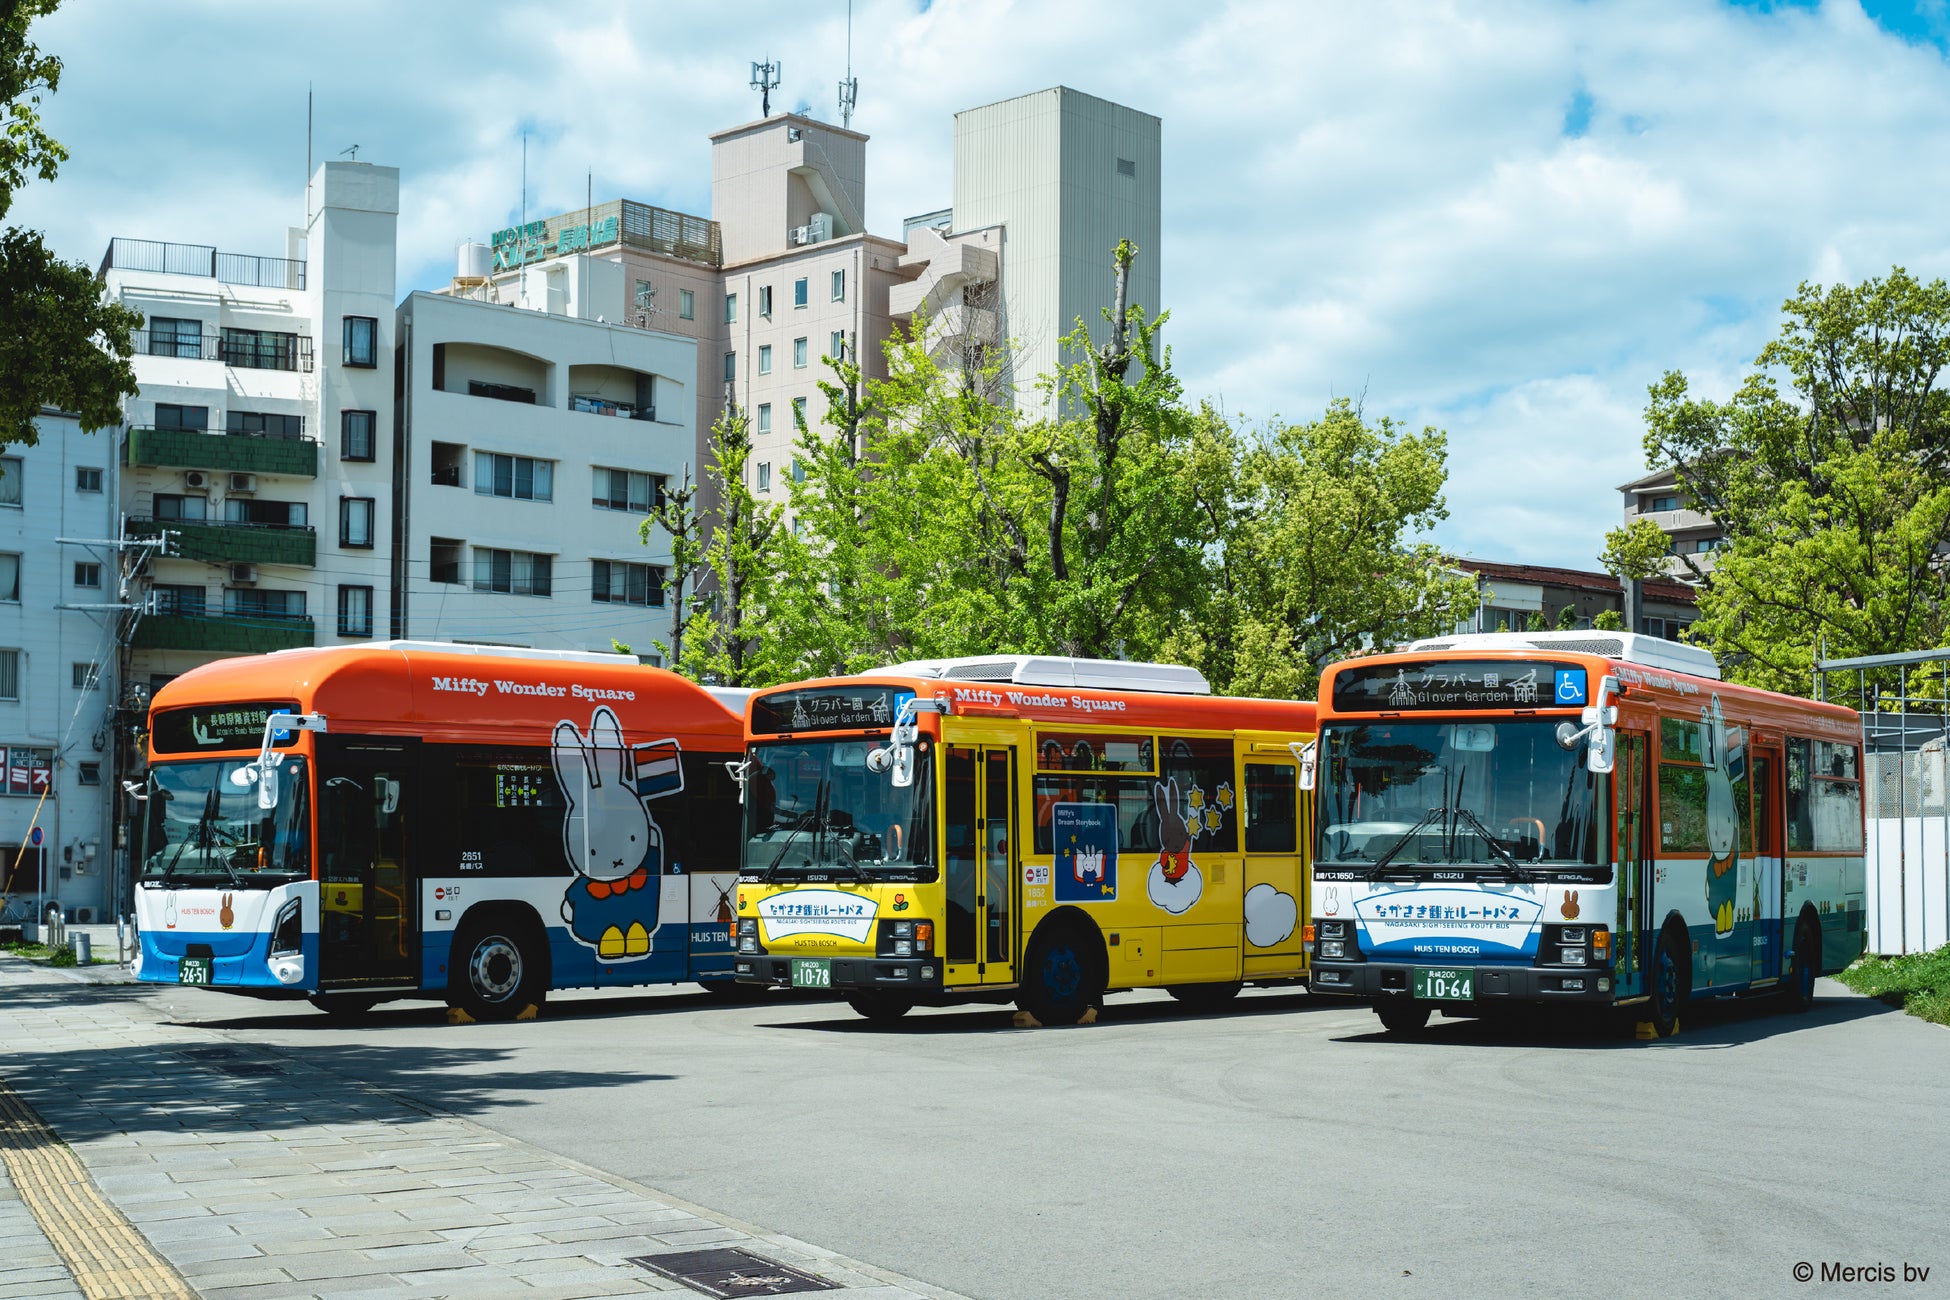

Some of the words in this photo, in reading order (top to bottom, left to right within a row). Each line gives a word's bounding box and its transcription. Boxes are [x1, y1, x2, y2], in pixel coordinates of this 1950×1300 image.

[491, 219, 546, 246] HOTEL
[1420, 673, 1499, 688] グラバー園
[1642, 671, 1672, 690] Wonder
[1671, 676, 1699, 697] Square
[432, 677, 489, 696] Miffy
[493, 680, 566, 696] Wonder
[571, 684, 636, 702] Square
[1418, 691, 1459, 702] Glover
[1464, 690, 1508, 702] Garden
[811, 697, 864, 713] グラバー園
[954, 688, 1002, 707] Miffy
[1005, 690, 1068, 707] Wonder
[1071, 695, 1126, 712] Square
[810, 714, 837, 725] Glover
[841, 713, 870, 723] Garden
[248, 726, 265, 734] Museu
[462, 851, 481, 861] 2651
[1433, 872, 1464, 880] ISUZU
[770, 904, 863, 916] ながさき観光ルートバス
[1375, 904, 1520, 919] ながさき観光ルートバス
[691, 932, 711, 942] HUIS
[712, 932, 728, 942] TEN
[1414, 945, 1432, 953] HUIS
[1434, 945, 1450, 953] TEN
[183, 967, 206, 983] 26-51
[800, 969, 829, 985] 10-78
[1427, 978, 1471, 998] 10-64
